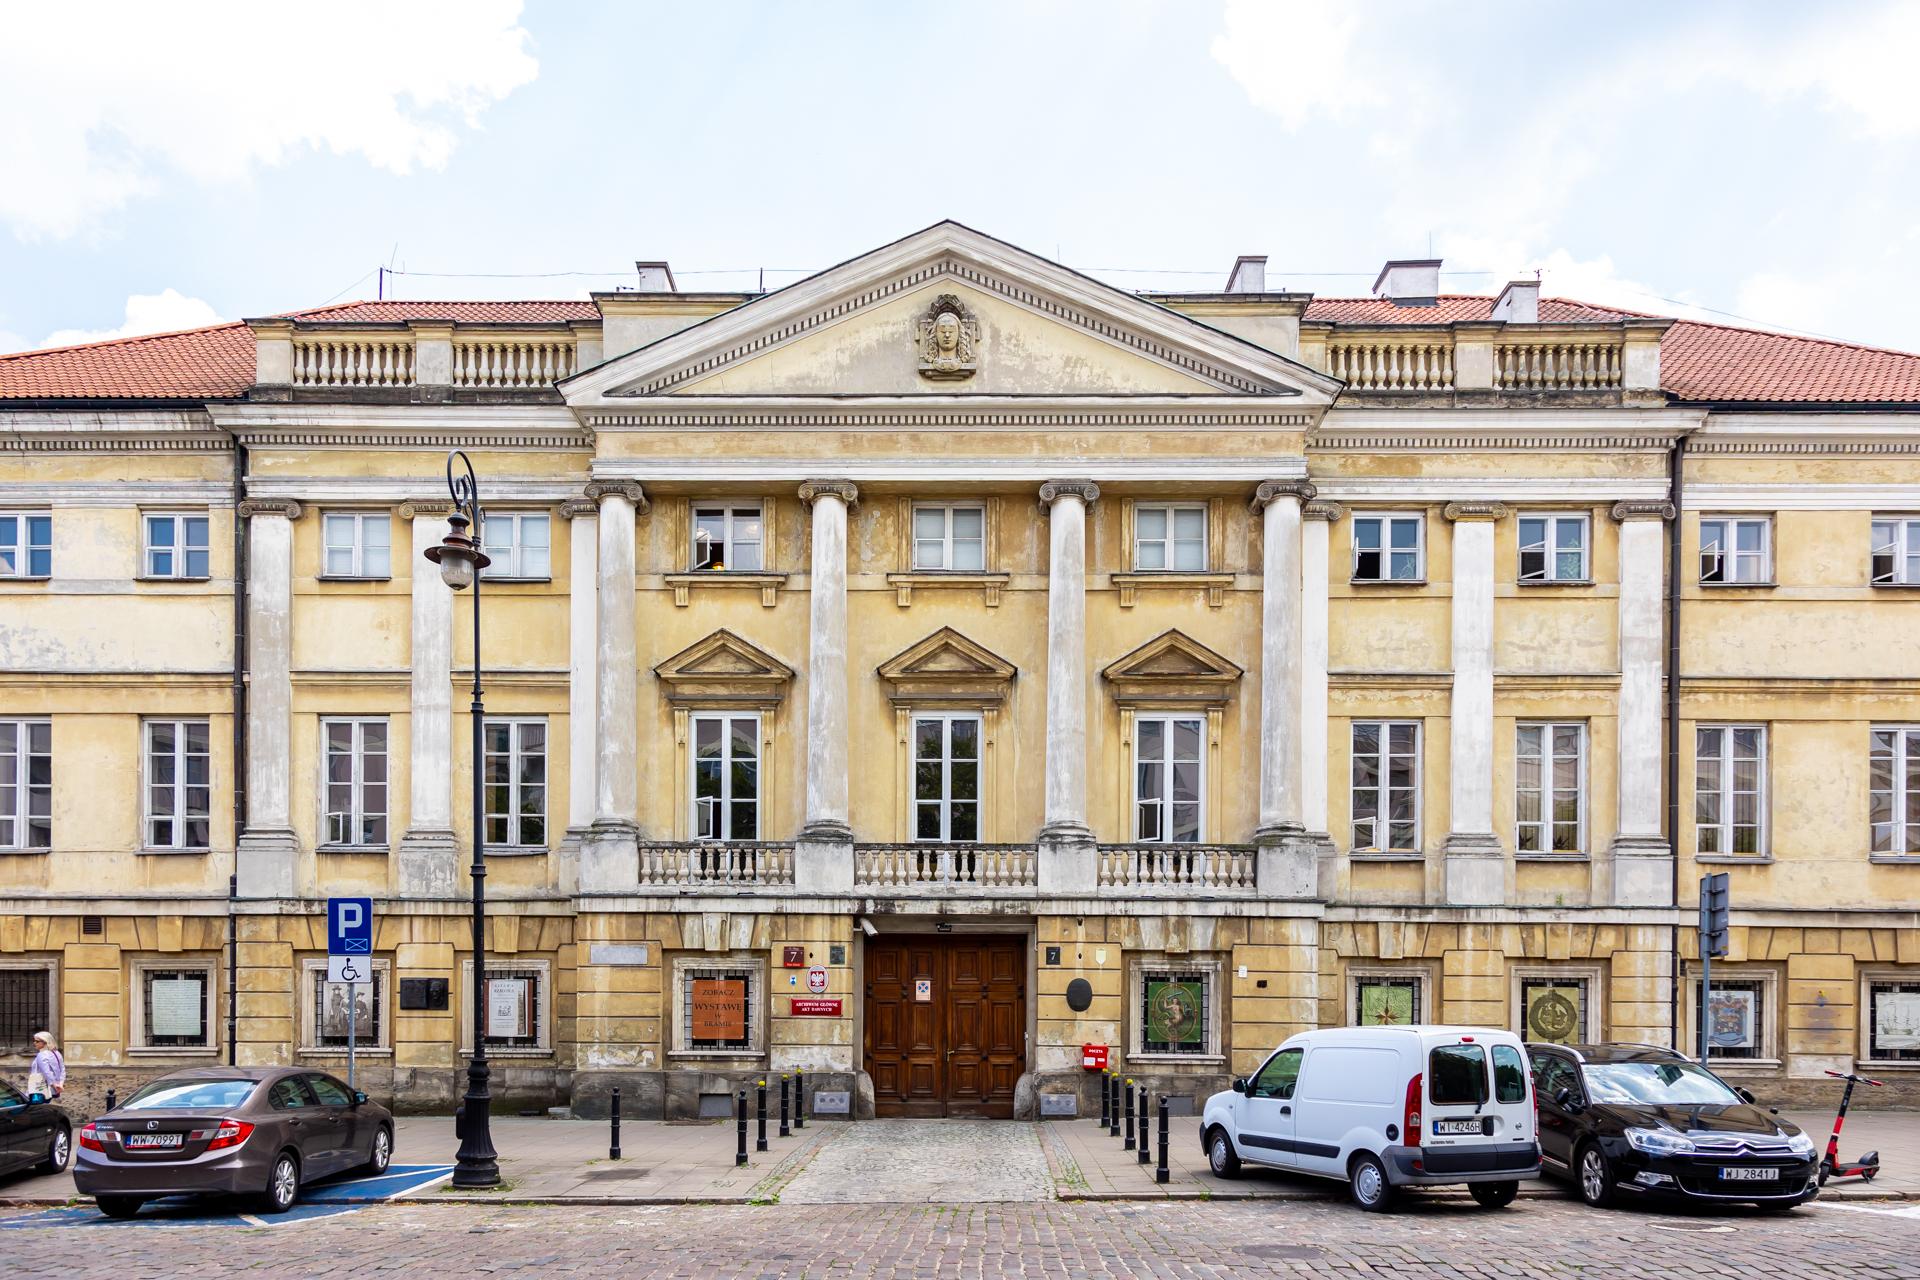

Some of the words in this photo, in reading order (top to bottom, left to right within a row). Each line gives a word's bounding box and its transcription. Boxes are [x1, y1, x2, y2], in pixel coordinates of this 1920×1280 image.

[338, 903, 363, 938] P
[790, 951, 797, 962] 7
[1050, 952, 1056, 960] 7
[695, 1003, 741, 1012] WYSTAWĘ
[1439, 1122, 1451, 1132] WI
[1454, 1122, 1481, 1132] 4246H
[132, 1135, 148, 1144] WW
[1743, 1169, 1776, 1179] 2841J
